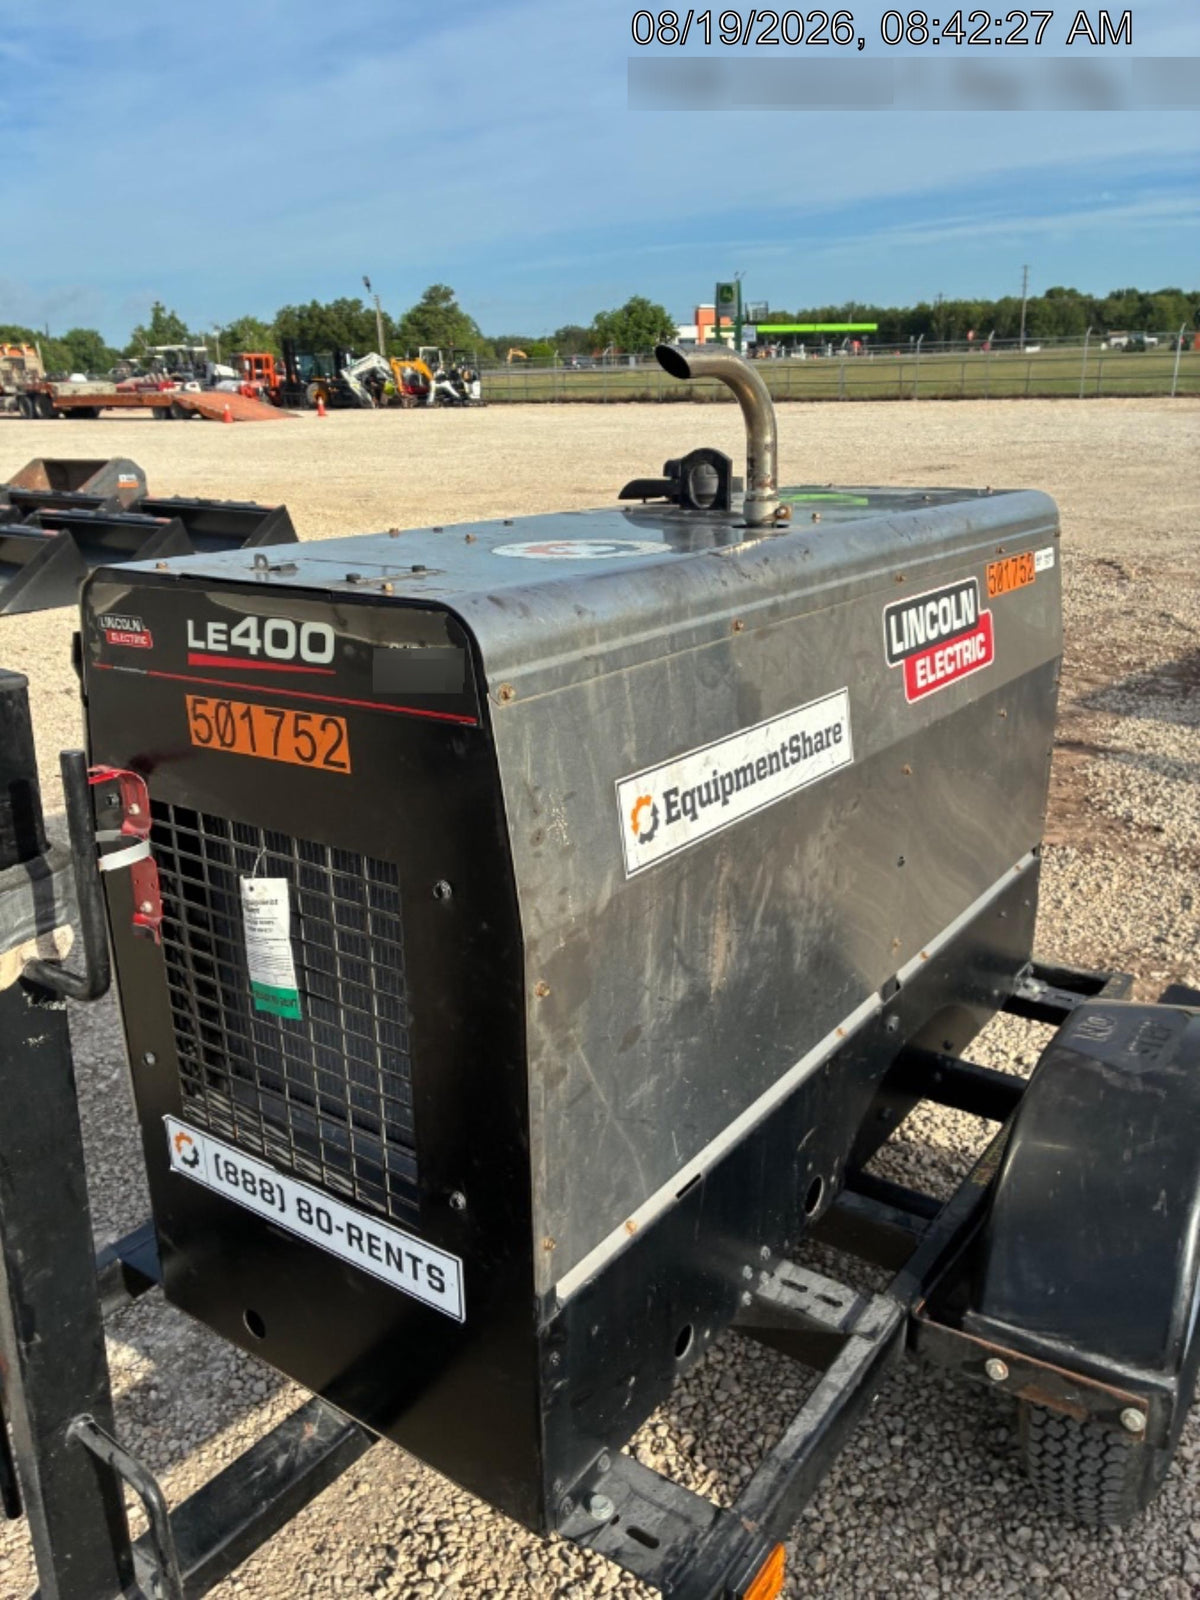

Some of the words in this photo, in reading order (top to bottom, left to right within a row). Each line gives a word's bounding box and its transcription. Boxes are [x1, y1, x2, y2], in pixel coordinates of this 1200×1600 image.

[99, 615, 142, 633] LINCOLN
[187, 615, 335, 664] LE400
[889, 587, 976, 656] LINCOLN
[914, 632, 987, 689] ELECTRIC
[662, 721, 843, 825] EquipmentShare
[213, 1152, 287, 1214] (888)
[296, 1197, 446, 1294] 80-RENTS
